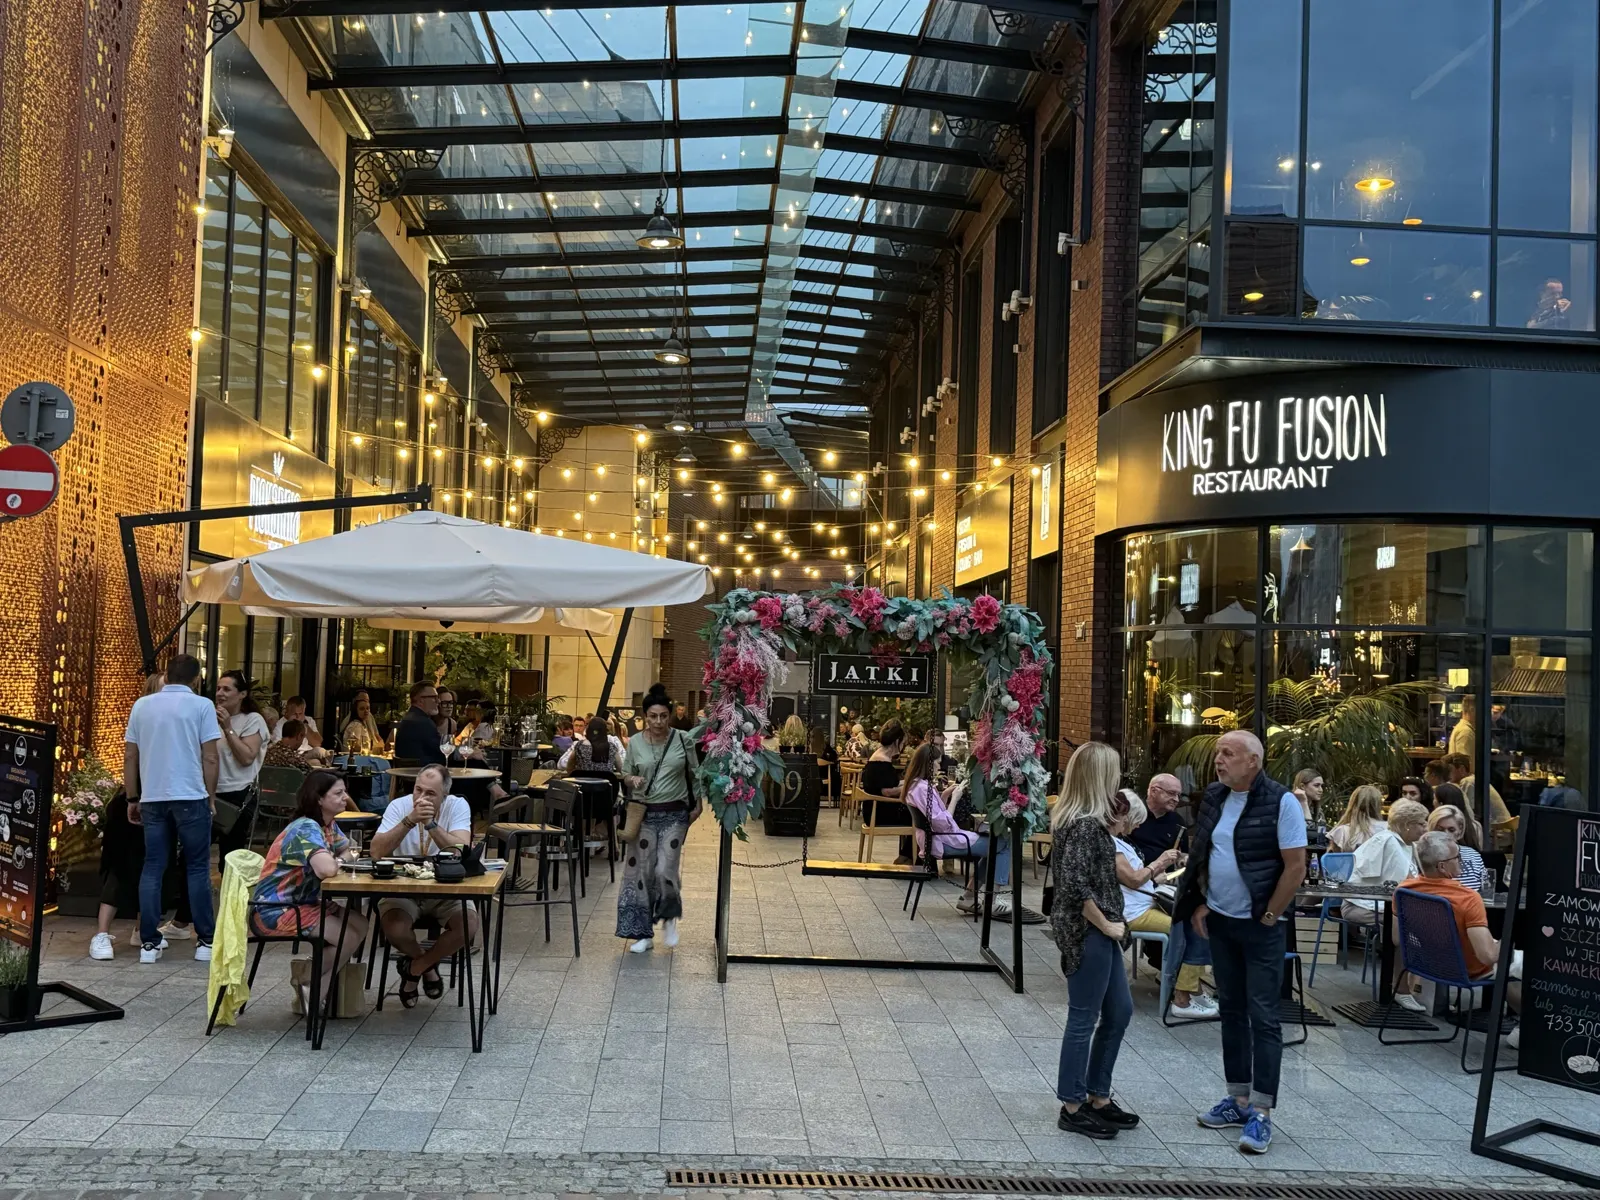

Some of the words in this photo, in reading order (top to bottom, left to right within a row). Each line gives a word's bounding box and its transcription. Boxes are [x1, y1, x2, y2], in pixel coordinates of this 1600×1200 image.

[1162, 404, 1213, 472] KING
[1227, 400, 1261, 467] FU
[1278, 393, 1386, 464] FUSION
[1193, 465, 1334, 496] RESTAURANT
[828, 661, 919, 683] JATKI
[1544, 892, 1600, 912] ZAMÓW
[1562, 912, 1580, 925] NA
[1565, 946, 1576, 957] W
[1544, 1014, 1573, 1033] 733
